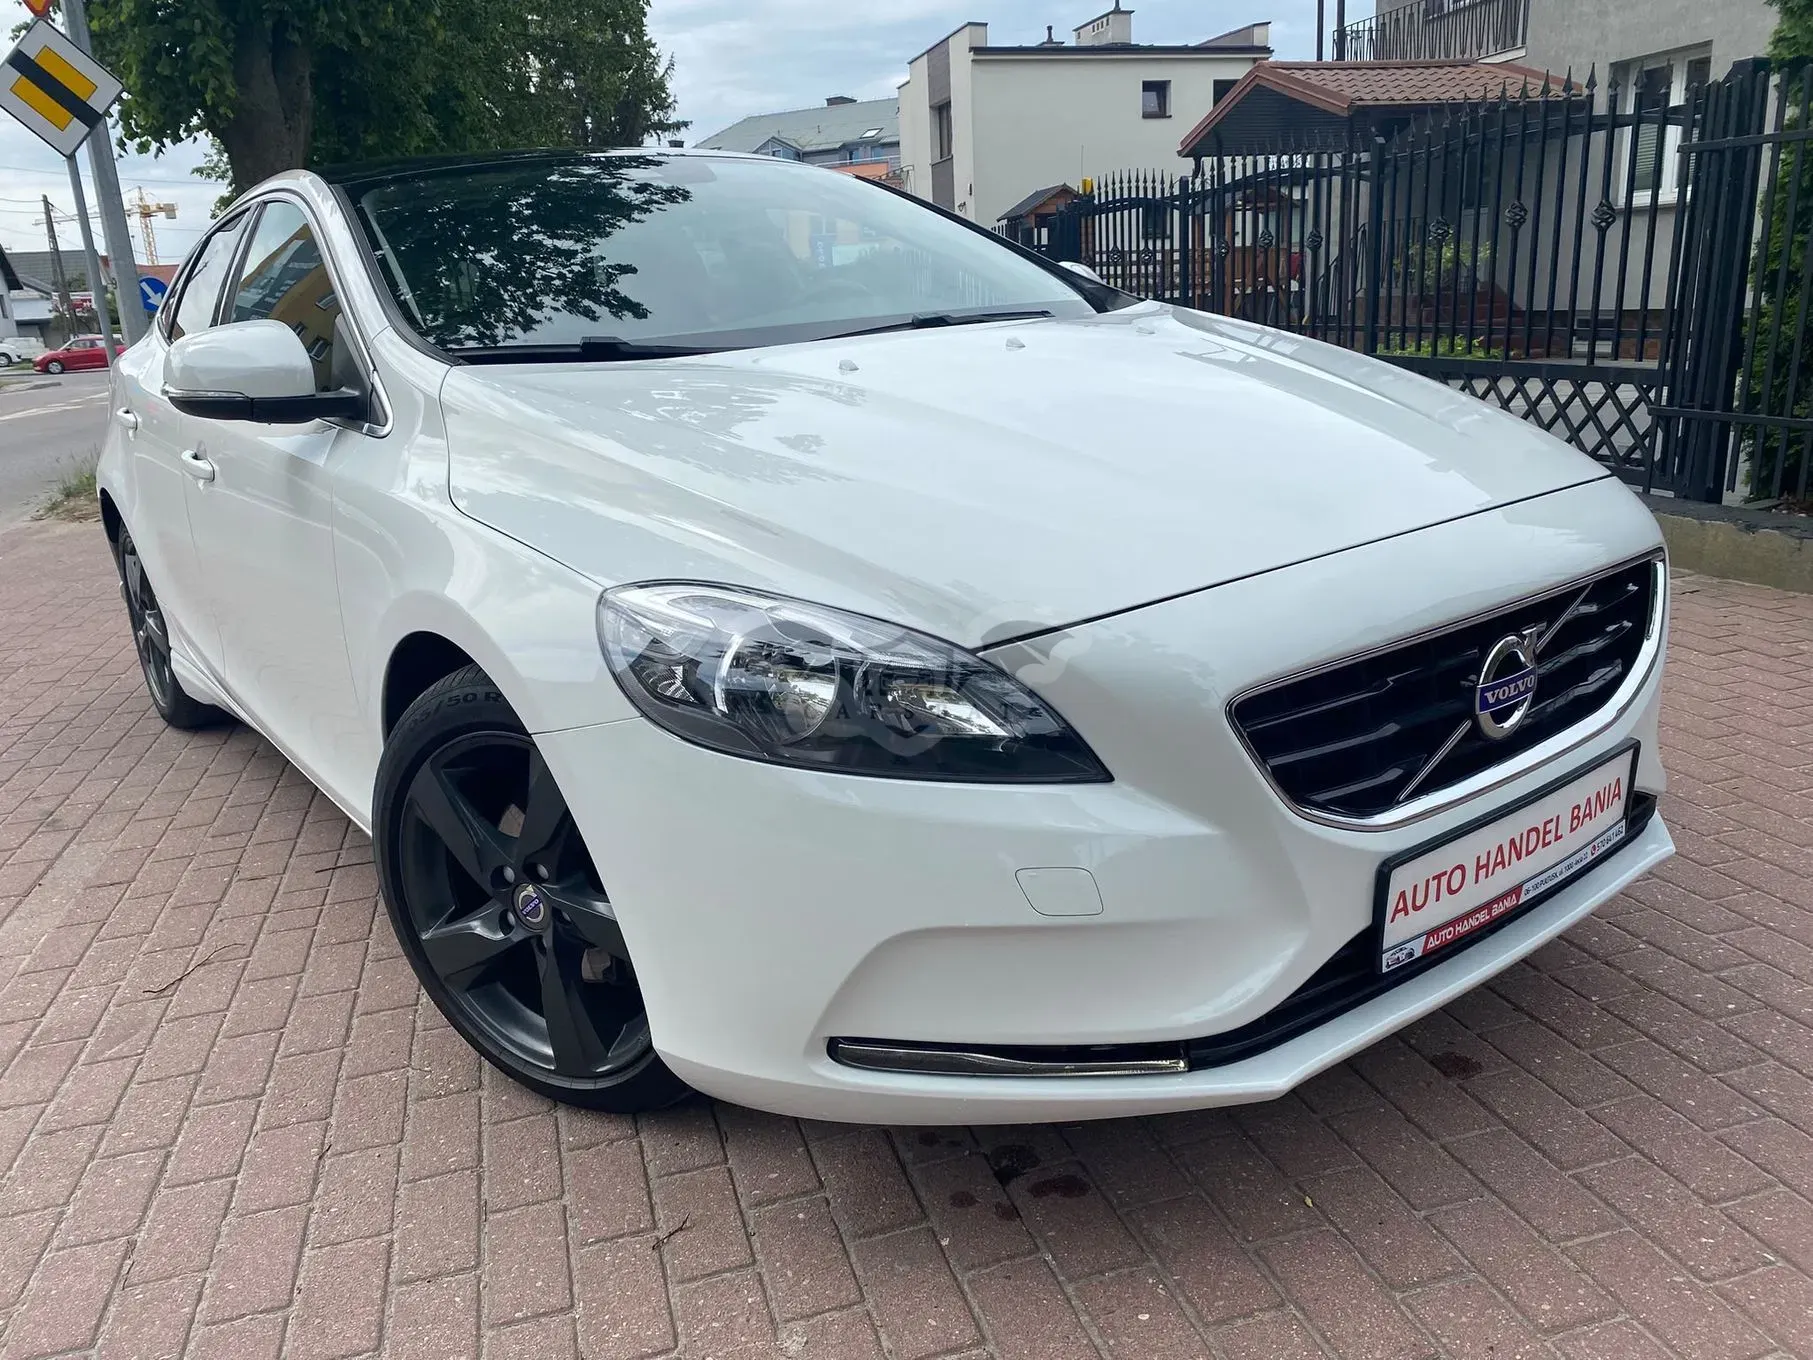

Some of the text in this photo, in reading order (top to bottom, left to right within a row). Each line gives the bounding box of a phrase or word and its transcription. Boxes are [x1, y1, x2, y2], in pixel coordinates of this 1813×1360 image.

[1484, 675, 1535, 704] VOLVO
[1389, 777, 1621, 924] AUTO HANDEL BANIA
[521, 898, 540, 915] VOLVO
[1426, 893, 1518, 949] AUTO HANDEL BANIA
